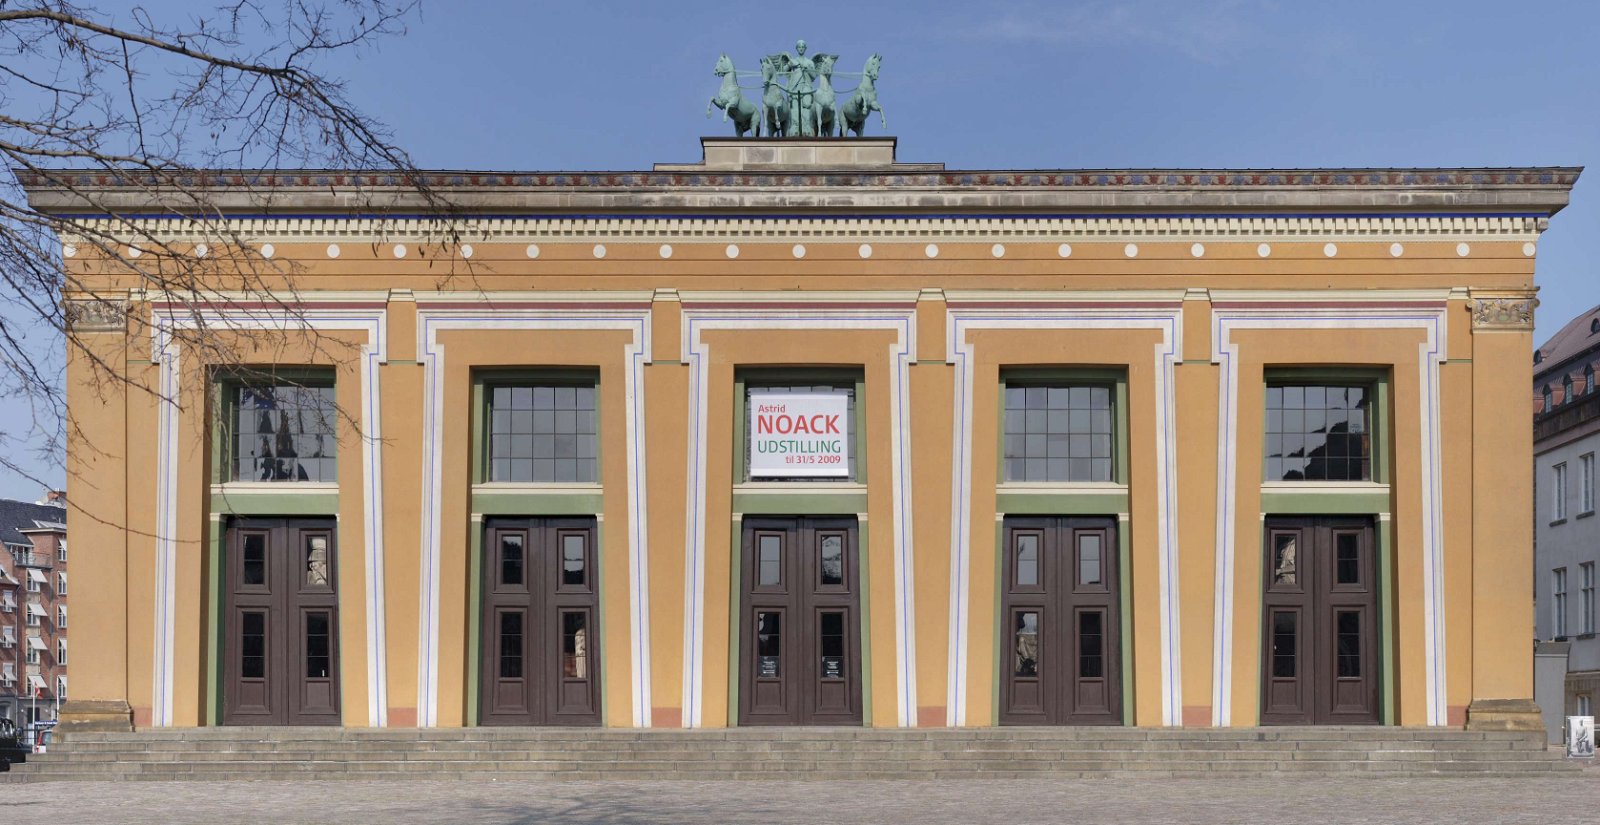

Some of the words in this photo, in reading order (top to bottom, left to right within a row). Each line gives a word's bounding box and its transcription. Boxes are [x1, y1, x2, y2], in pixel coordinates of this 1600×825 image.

[758, 404, 786, 413] Astrid
[757, 415, 840, 434] NOACK
[758, 440, 841, 453] UDSTILLING
[785, 455, 794, 464] til
[796, 455, 815, 464] 31/5
[817, 455, 841, 464] 2009
